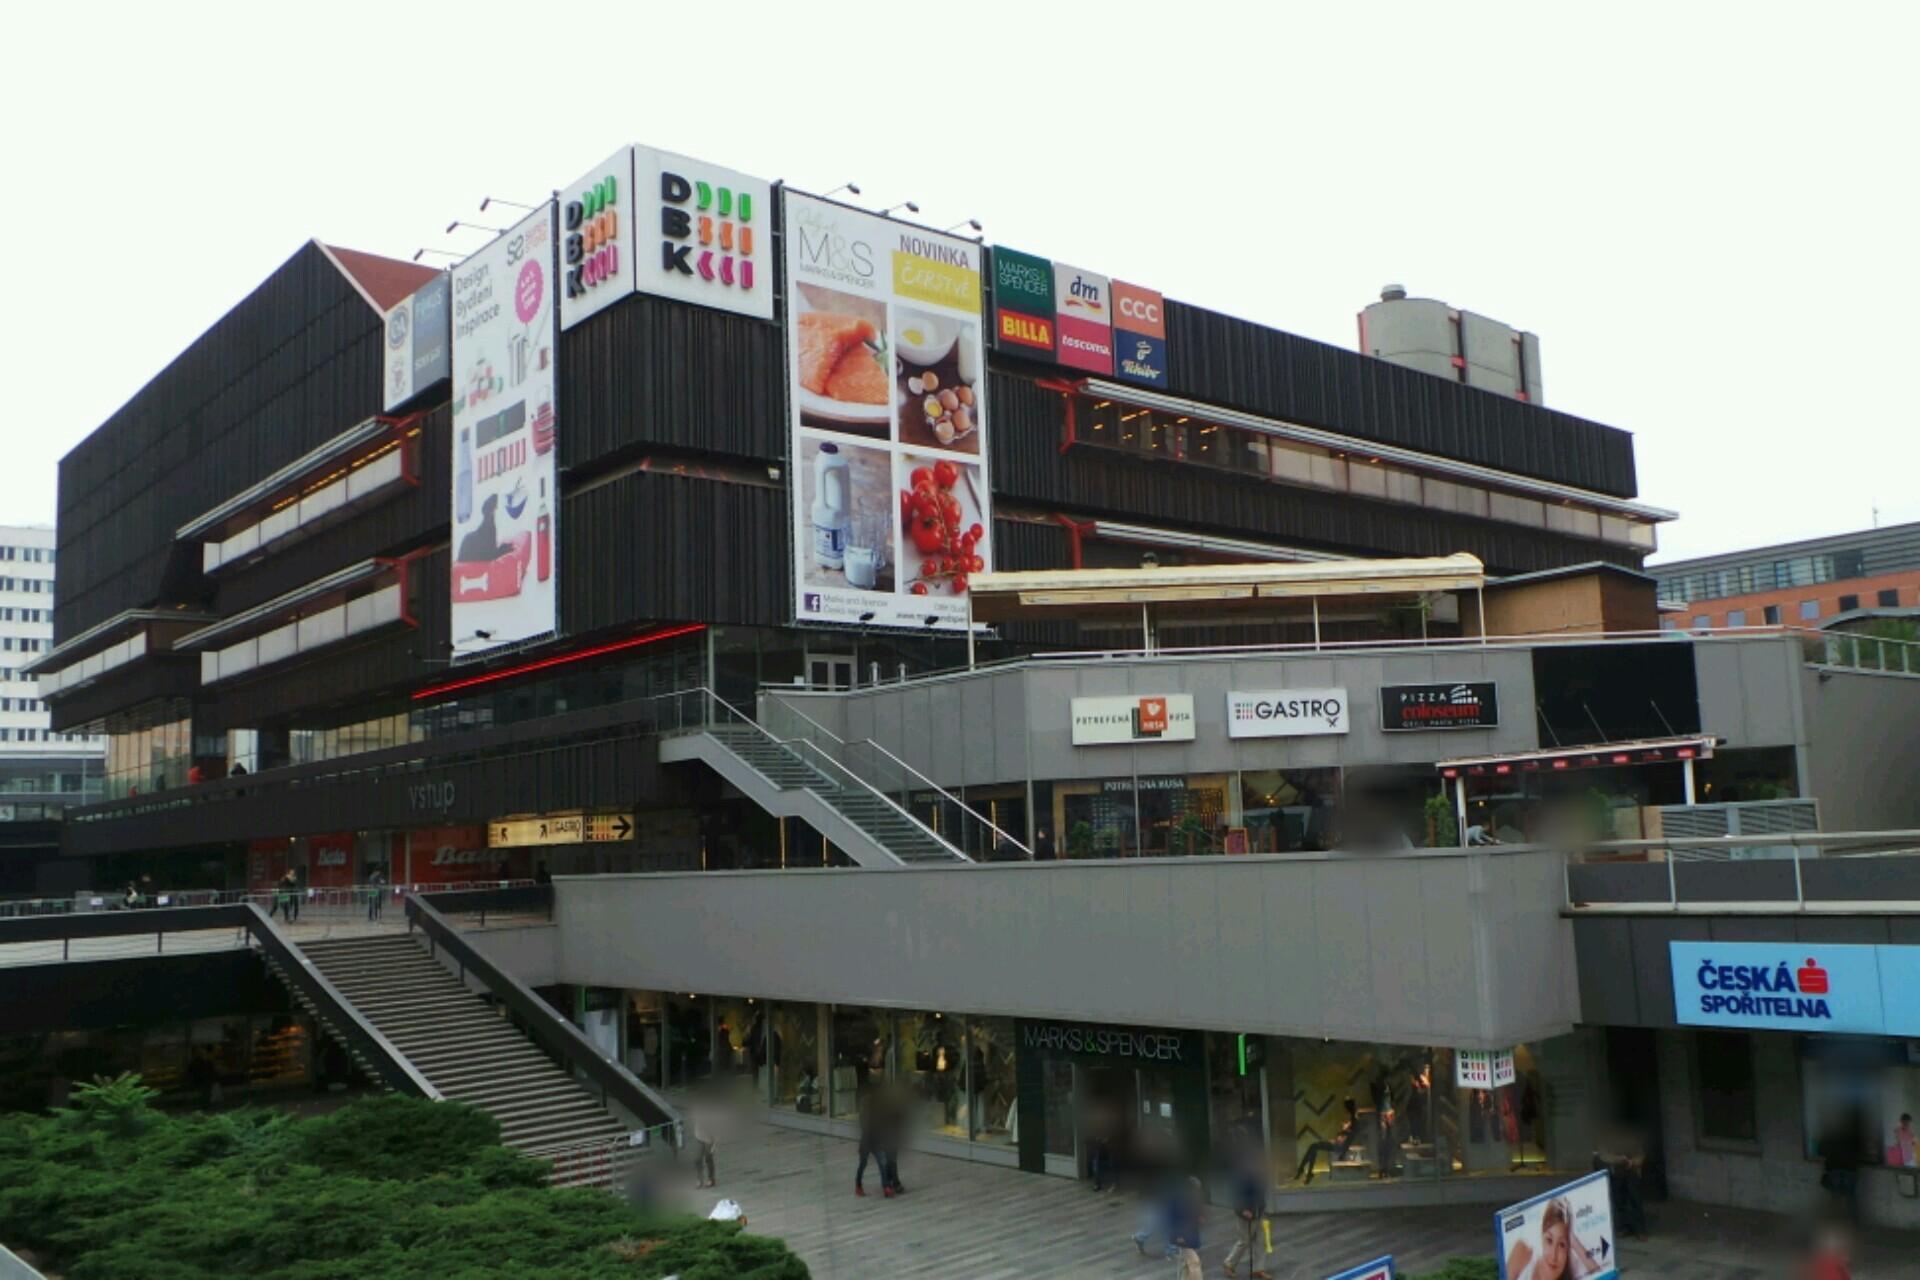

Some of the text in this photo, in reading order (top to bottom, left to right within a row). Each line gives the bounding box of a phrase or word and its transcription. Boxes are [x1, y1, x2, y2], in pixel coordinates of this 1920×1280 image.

[799, 226, 875, 277] M&S
[900, 234, 970, 269] NOVINKA
[999, 272, 1048, 297] SPENCER
[1070, 276, 1099, 301] dm
[1119, 297, 1159, 323] CCC
[1002, 315, 1050, 345] BILLA
[1255, 699, 1341, 720] GASTRO
[1400, 692, 1447, 702] PIZZA
[1401, 704, 1480, 720] coloseum
[408, 780, 455, 813] vstup
[1697, 959, 1796, 993] ČESKÁ
[1701, 991, 1831, 1019] SPOŘITELNA
